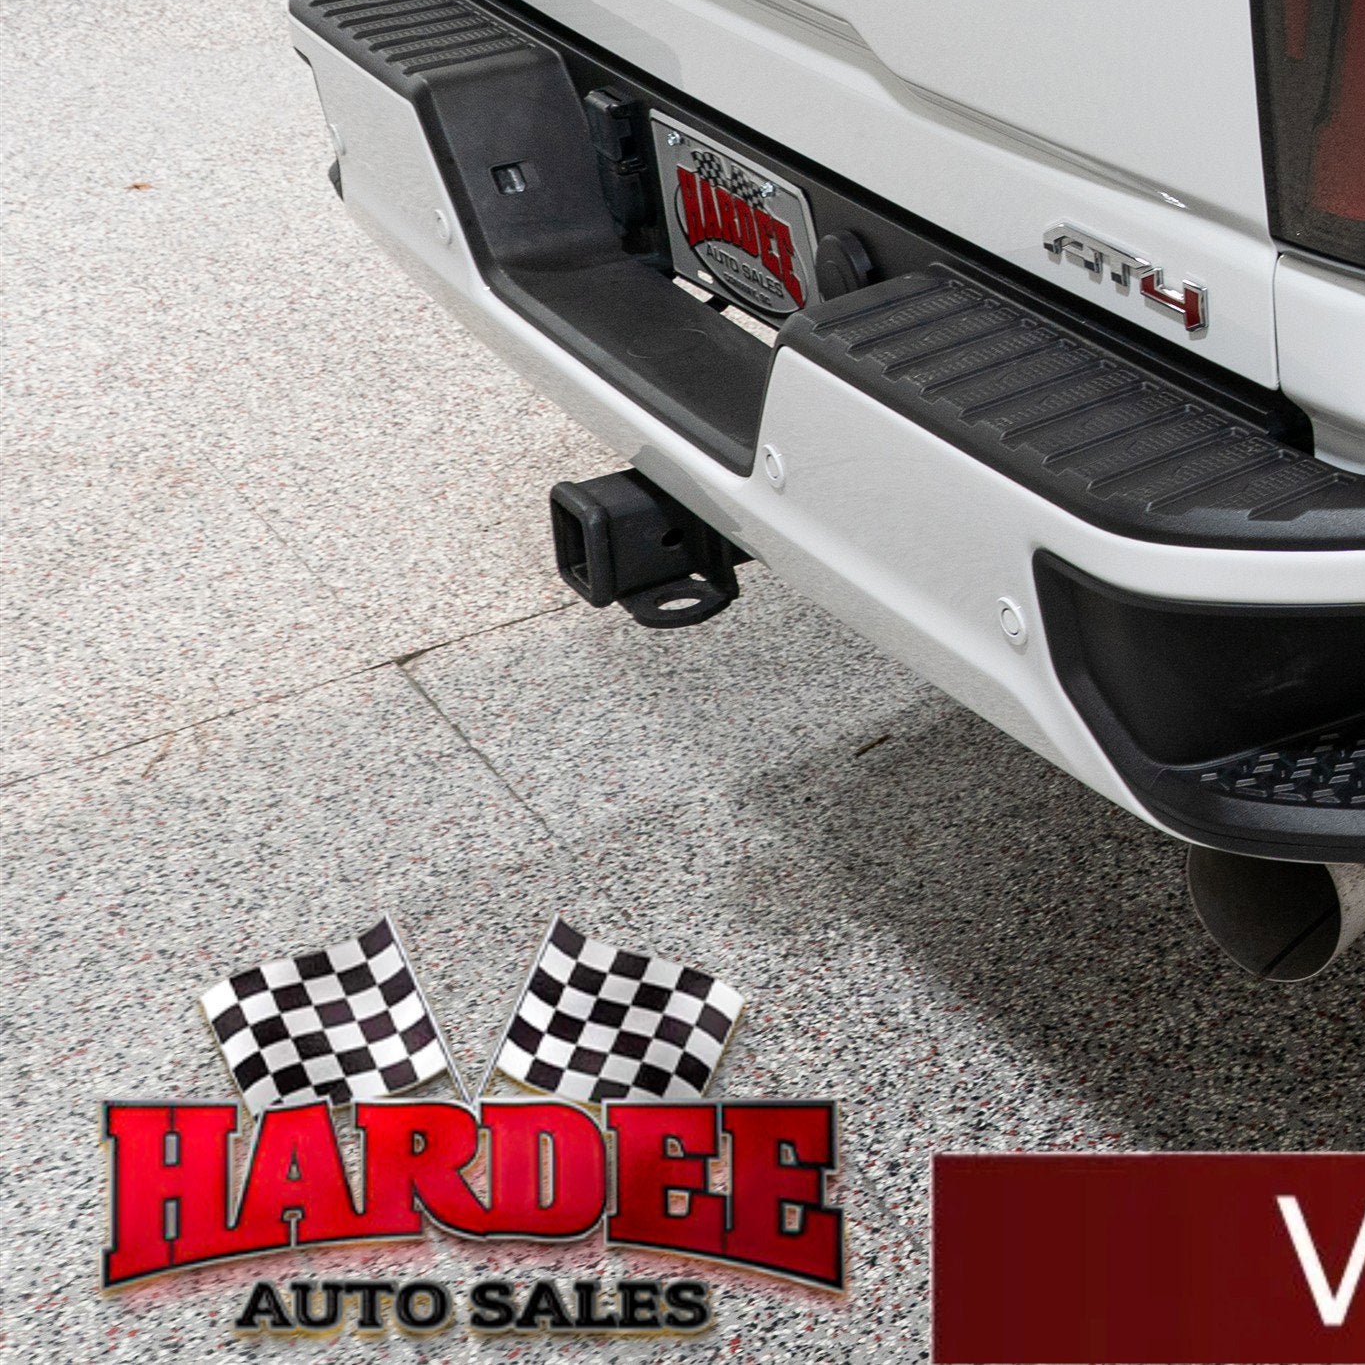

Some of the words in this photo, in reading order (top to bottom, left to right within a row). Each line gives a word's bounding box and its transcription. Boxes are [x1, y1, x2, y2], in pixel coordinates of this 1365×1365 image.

[676, 165, 806, 310] HARDEE
[705, 244, 740, 273] AUTO
[741, 263, 784, 298] SALES
[1043, 222, 1210, 333] AT4
